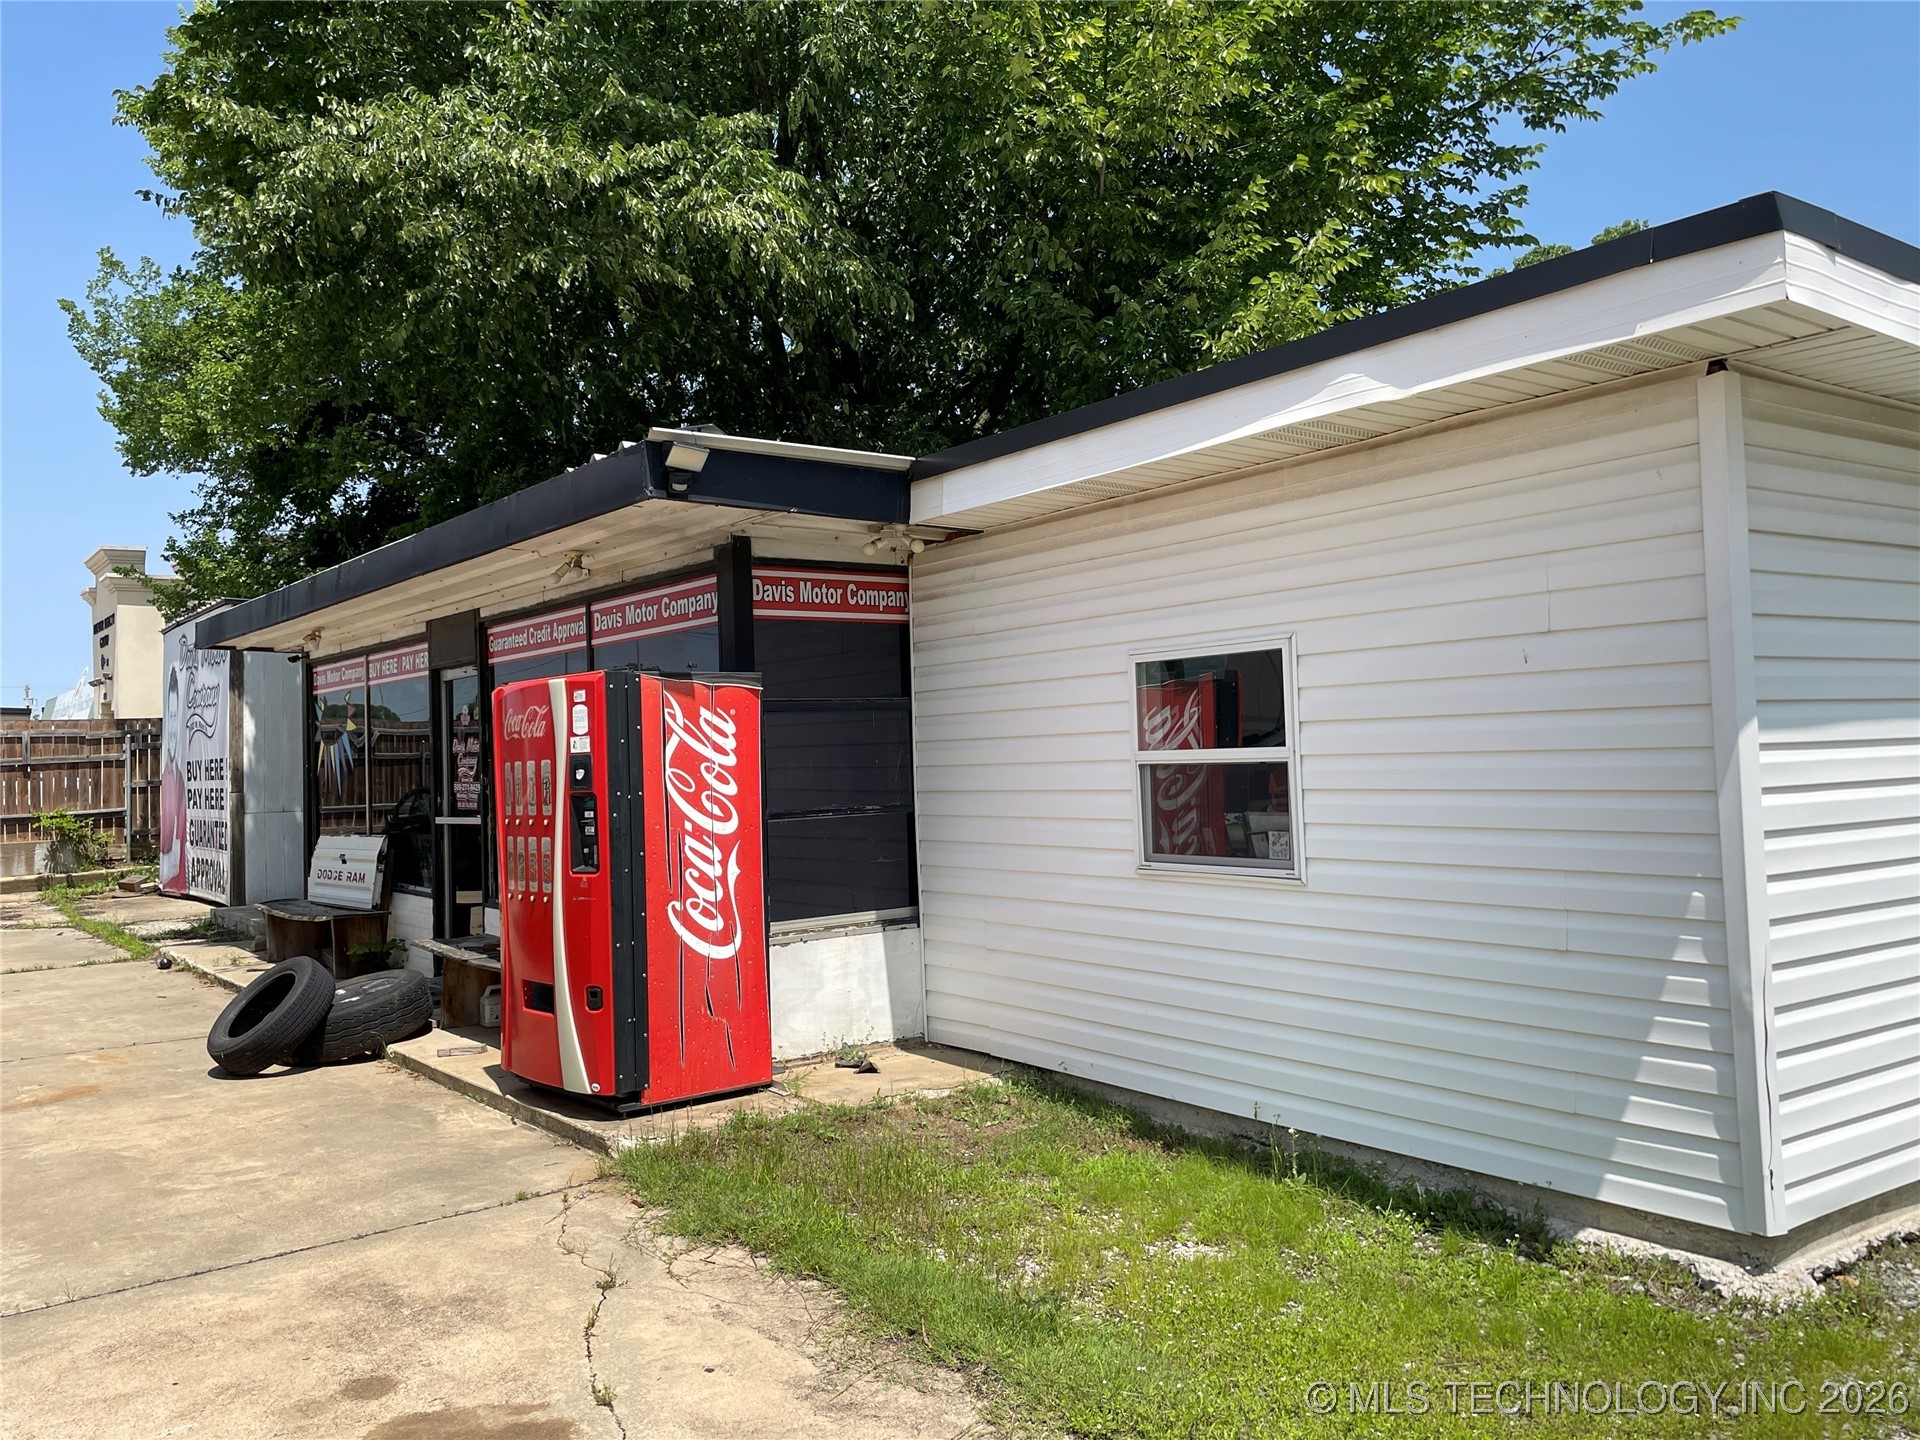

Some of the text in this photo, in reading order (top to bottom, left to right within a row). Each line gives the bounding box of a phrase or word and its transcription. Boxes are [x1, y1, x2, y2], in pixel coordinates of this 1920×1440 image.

[752, 579, 909, 613] Davis Motor Company
[594, 591, 718, 632] Davis Motor Company
[489, 618, 587, 653] Guaranteed Credit Approval
[313, 665, 365, 687] Davis Motor Company
[369, 660, 380, 678] BUY
[382, 658, 398, 674] HERE
[402, 654, 414, 671] PAY
[415, 651, 429, 670] HER
[186, 760, 203, 782] BUY
[205, 758, 224, 781] HERE
[187, 788, 203, 809] PAY
[205, 787, 225, 811] HERE
[317, 868, 366, 884] DODGE RAM
